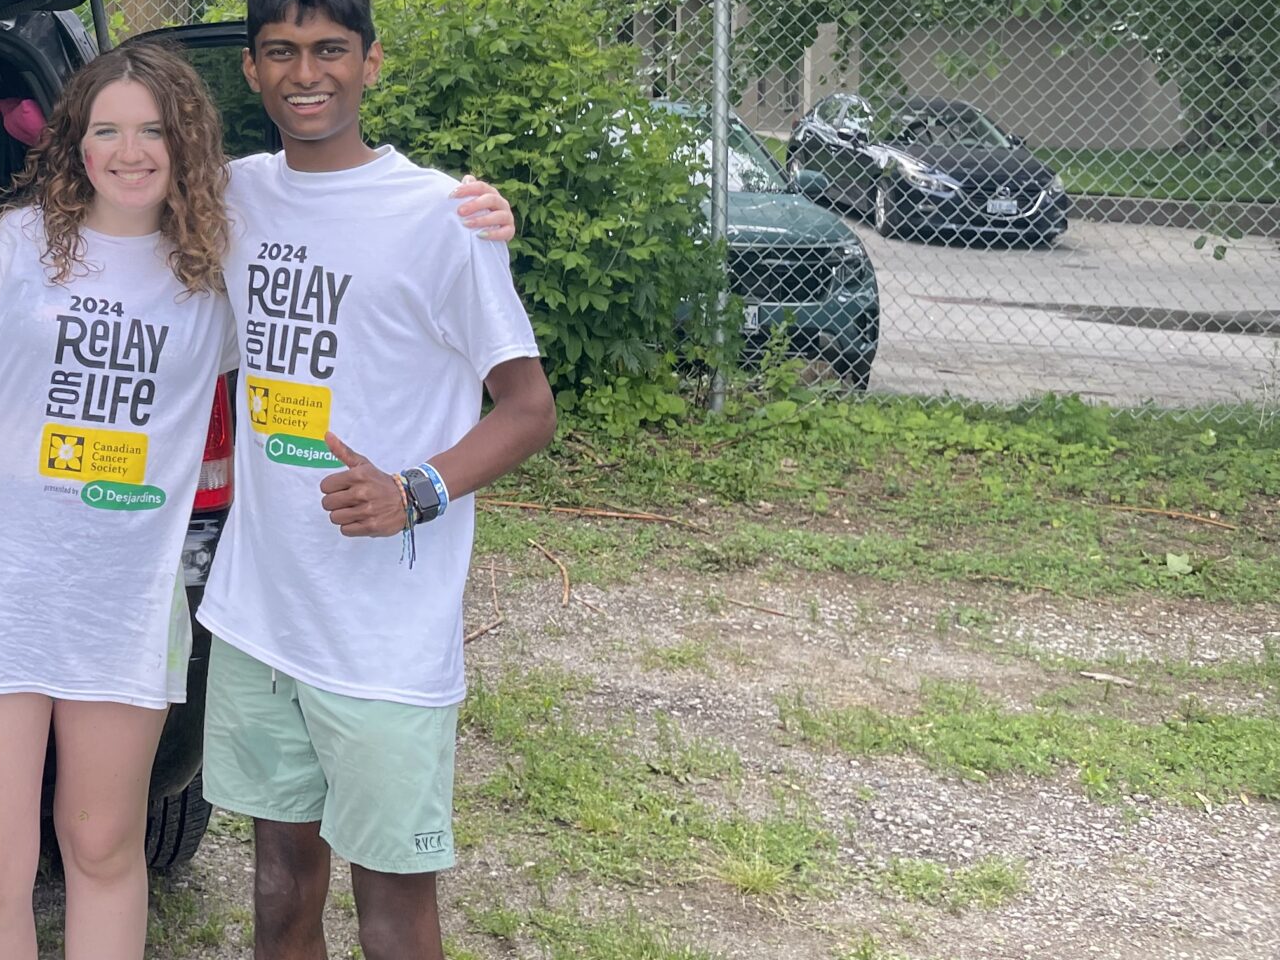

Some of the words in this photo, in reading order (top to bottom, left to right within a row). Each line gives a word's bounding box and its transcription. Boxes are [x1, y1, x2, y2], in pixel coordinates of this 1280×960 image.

[257, 242, 307, 264] 2024
[69, 295, 124, 318] 2024
[246, 319, 266, 371] FOR
[46, 369, 83, 420] FOR
[274, 392, 323, 409] Canadian
[273, 404, 308, 418] Cancer
[272, 415, 309, 431] Society
[93, 441, 142, 456] Canadian
[286, 443, 338, 461] Desjard
[91, 451, 128, 464] Cancer
[90, 461, 128, 477] Society
[106, 490, 162, 505] Desjardins
